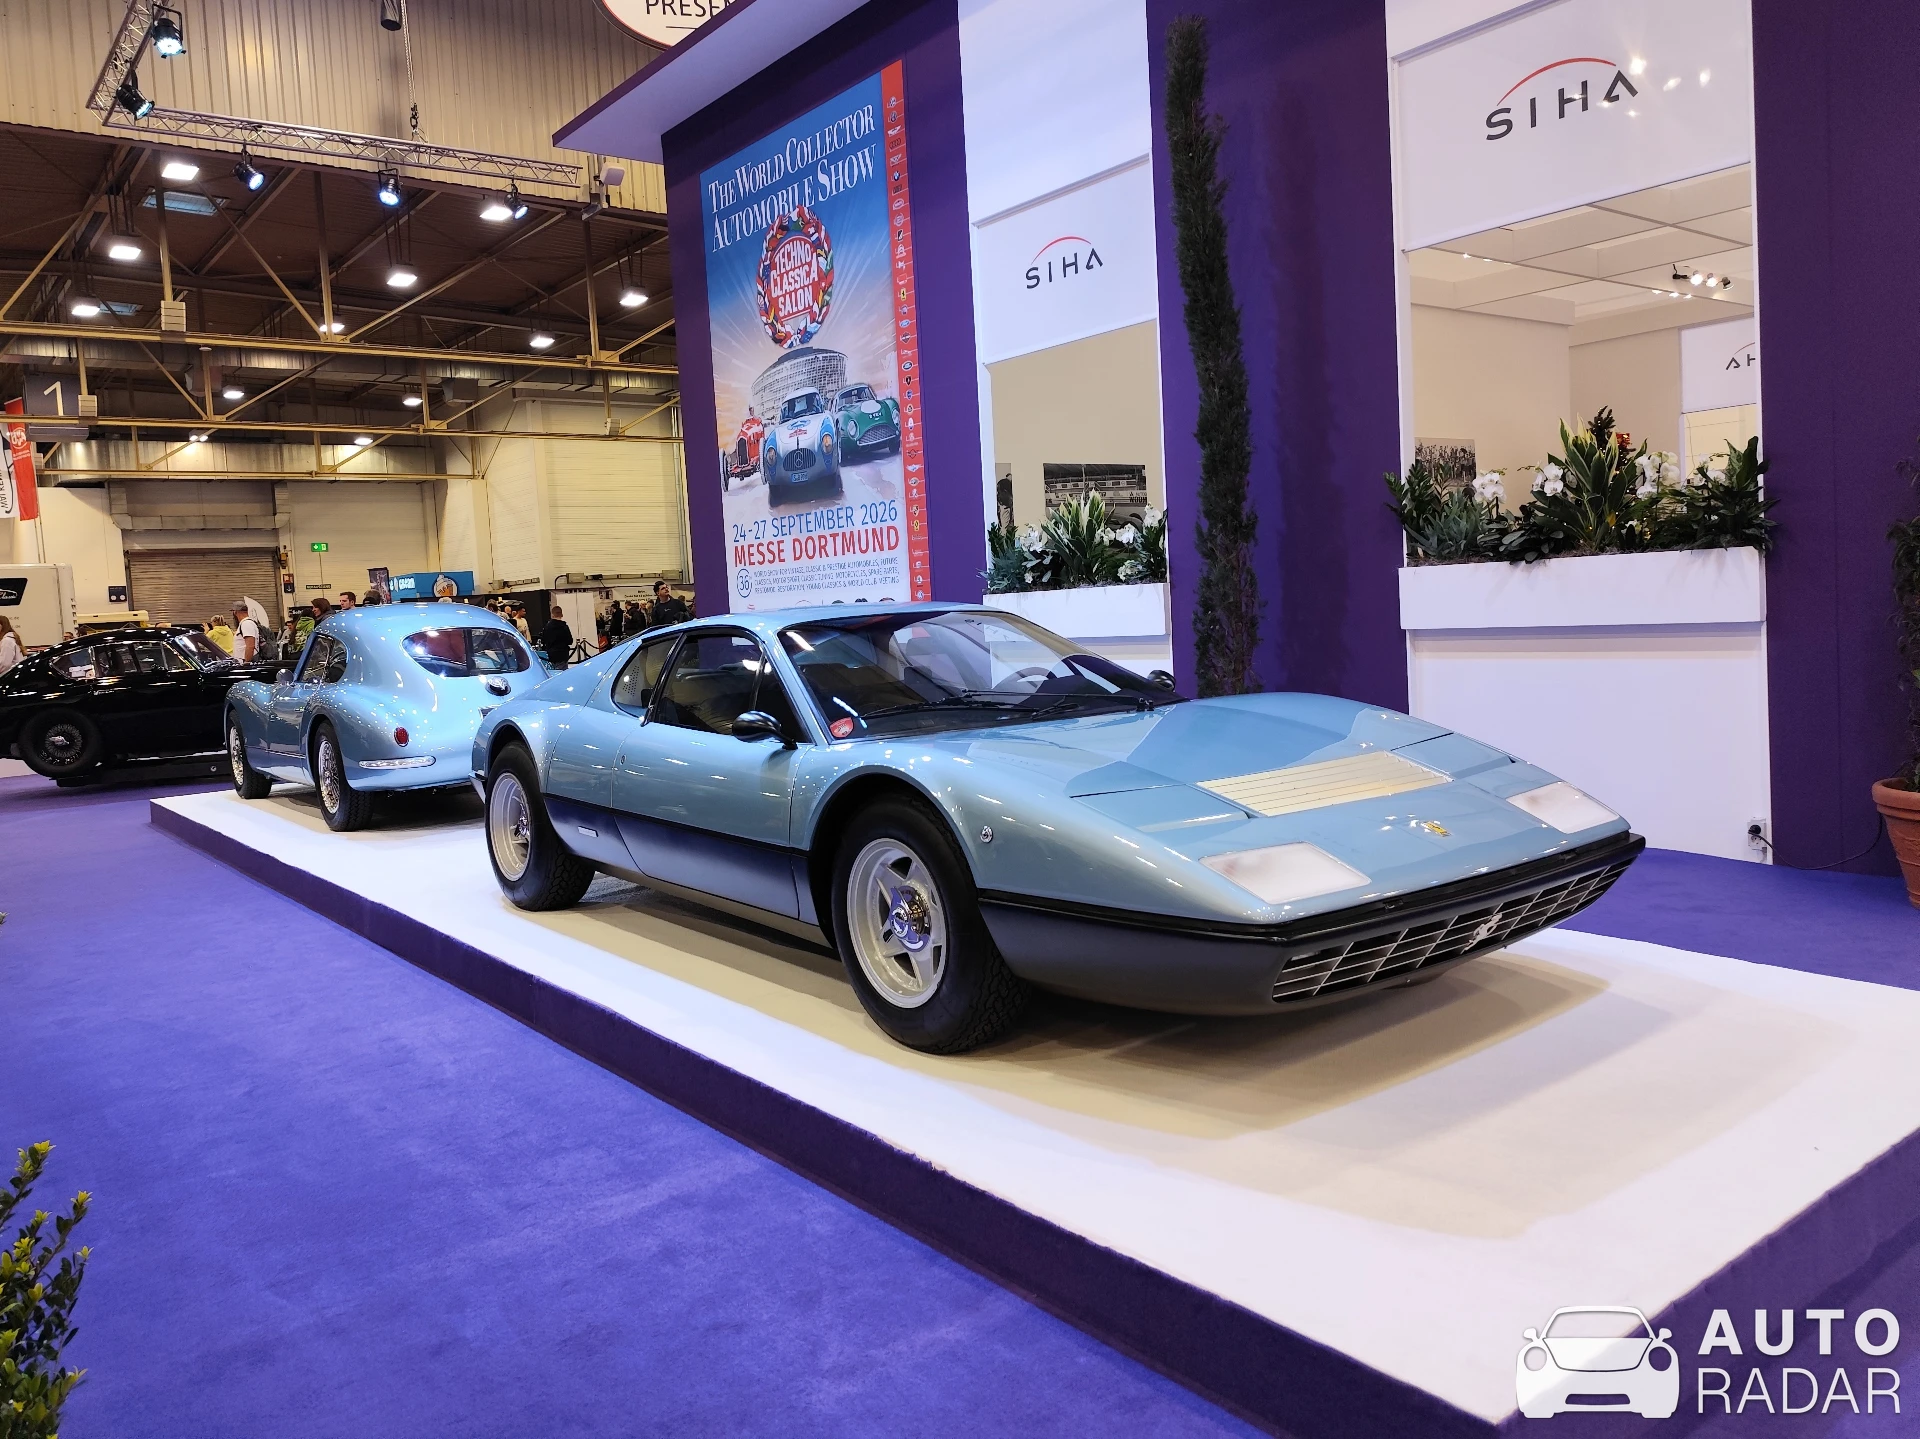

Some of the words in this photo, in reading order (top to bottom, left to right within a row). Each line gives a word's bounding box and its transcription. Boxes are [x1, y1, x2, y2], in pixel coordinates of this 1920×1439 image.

[1486, 69, 1638, 141] SIHA
[708, 180, 737, 214] THE
[735, 153, 785, 201] WORLD
[785, 104, 876, 174] COLLECTOR
[712, 176, 815, 253] AUTOMOBILE
[817, 144, 877, 202] SHOW
[770, 253, 818, 298] CLASSICA
[774, 240, 811, 275] TECHNO
[1025, 248, 1103, 289] SIHA
[778, 285, 813, 317] SALON
[43, 381, 64, 416] 1
[732, 520, 767, 543] 24-27
[771, 505, 855, 538] SEPTEMBER
[860, 500, 898, 526] 2026
[734, 539, 785, 567] MESSE
[792, 525, 900, 562] DORTMUND
